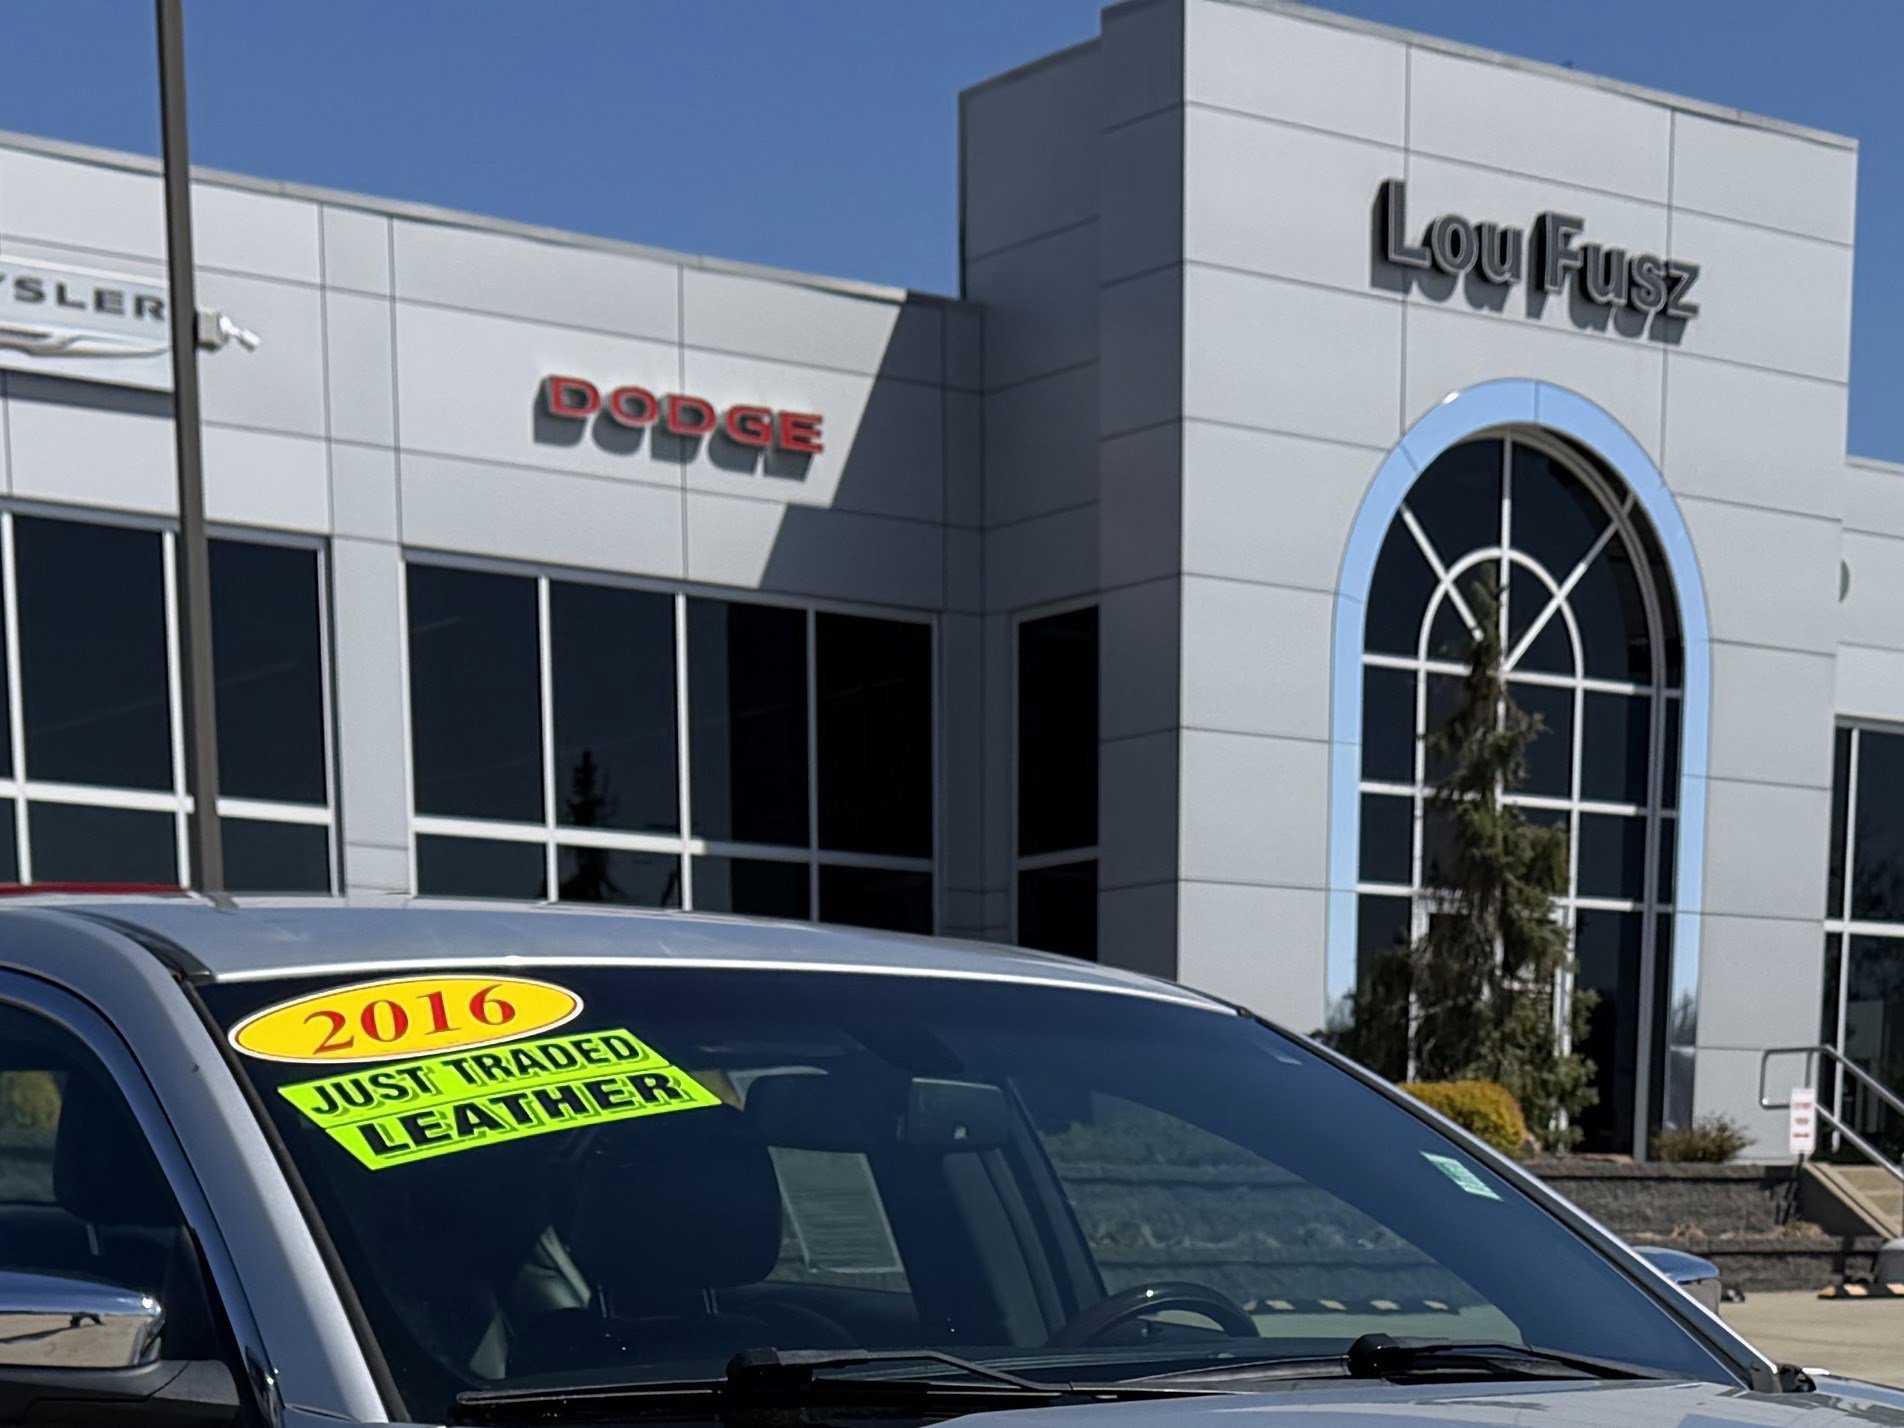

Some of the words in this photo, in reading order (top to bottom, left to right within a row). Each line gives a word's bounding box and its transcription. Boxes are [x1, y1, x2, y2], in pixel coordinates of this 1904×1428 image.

[1383, 177, 1524, 285] Lou
[1540, 210, 1701, 319] Fusz
[546, 374, 825, 454] DODGE
[303, 984, 517, 1056] 2016
[309, 1065, 434, 1116] JUST
[445, 1036, 641, 1089] TRADED
[357, 1072, 696, 1158] LEATHER
